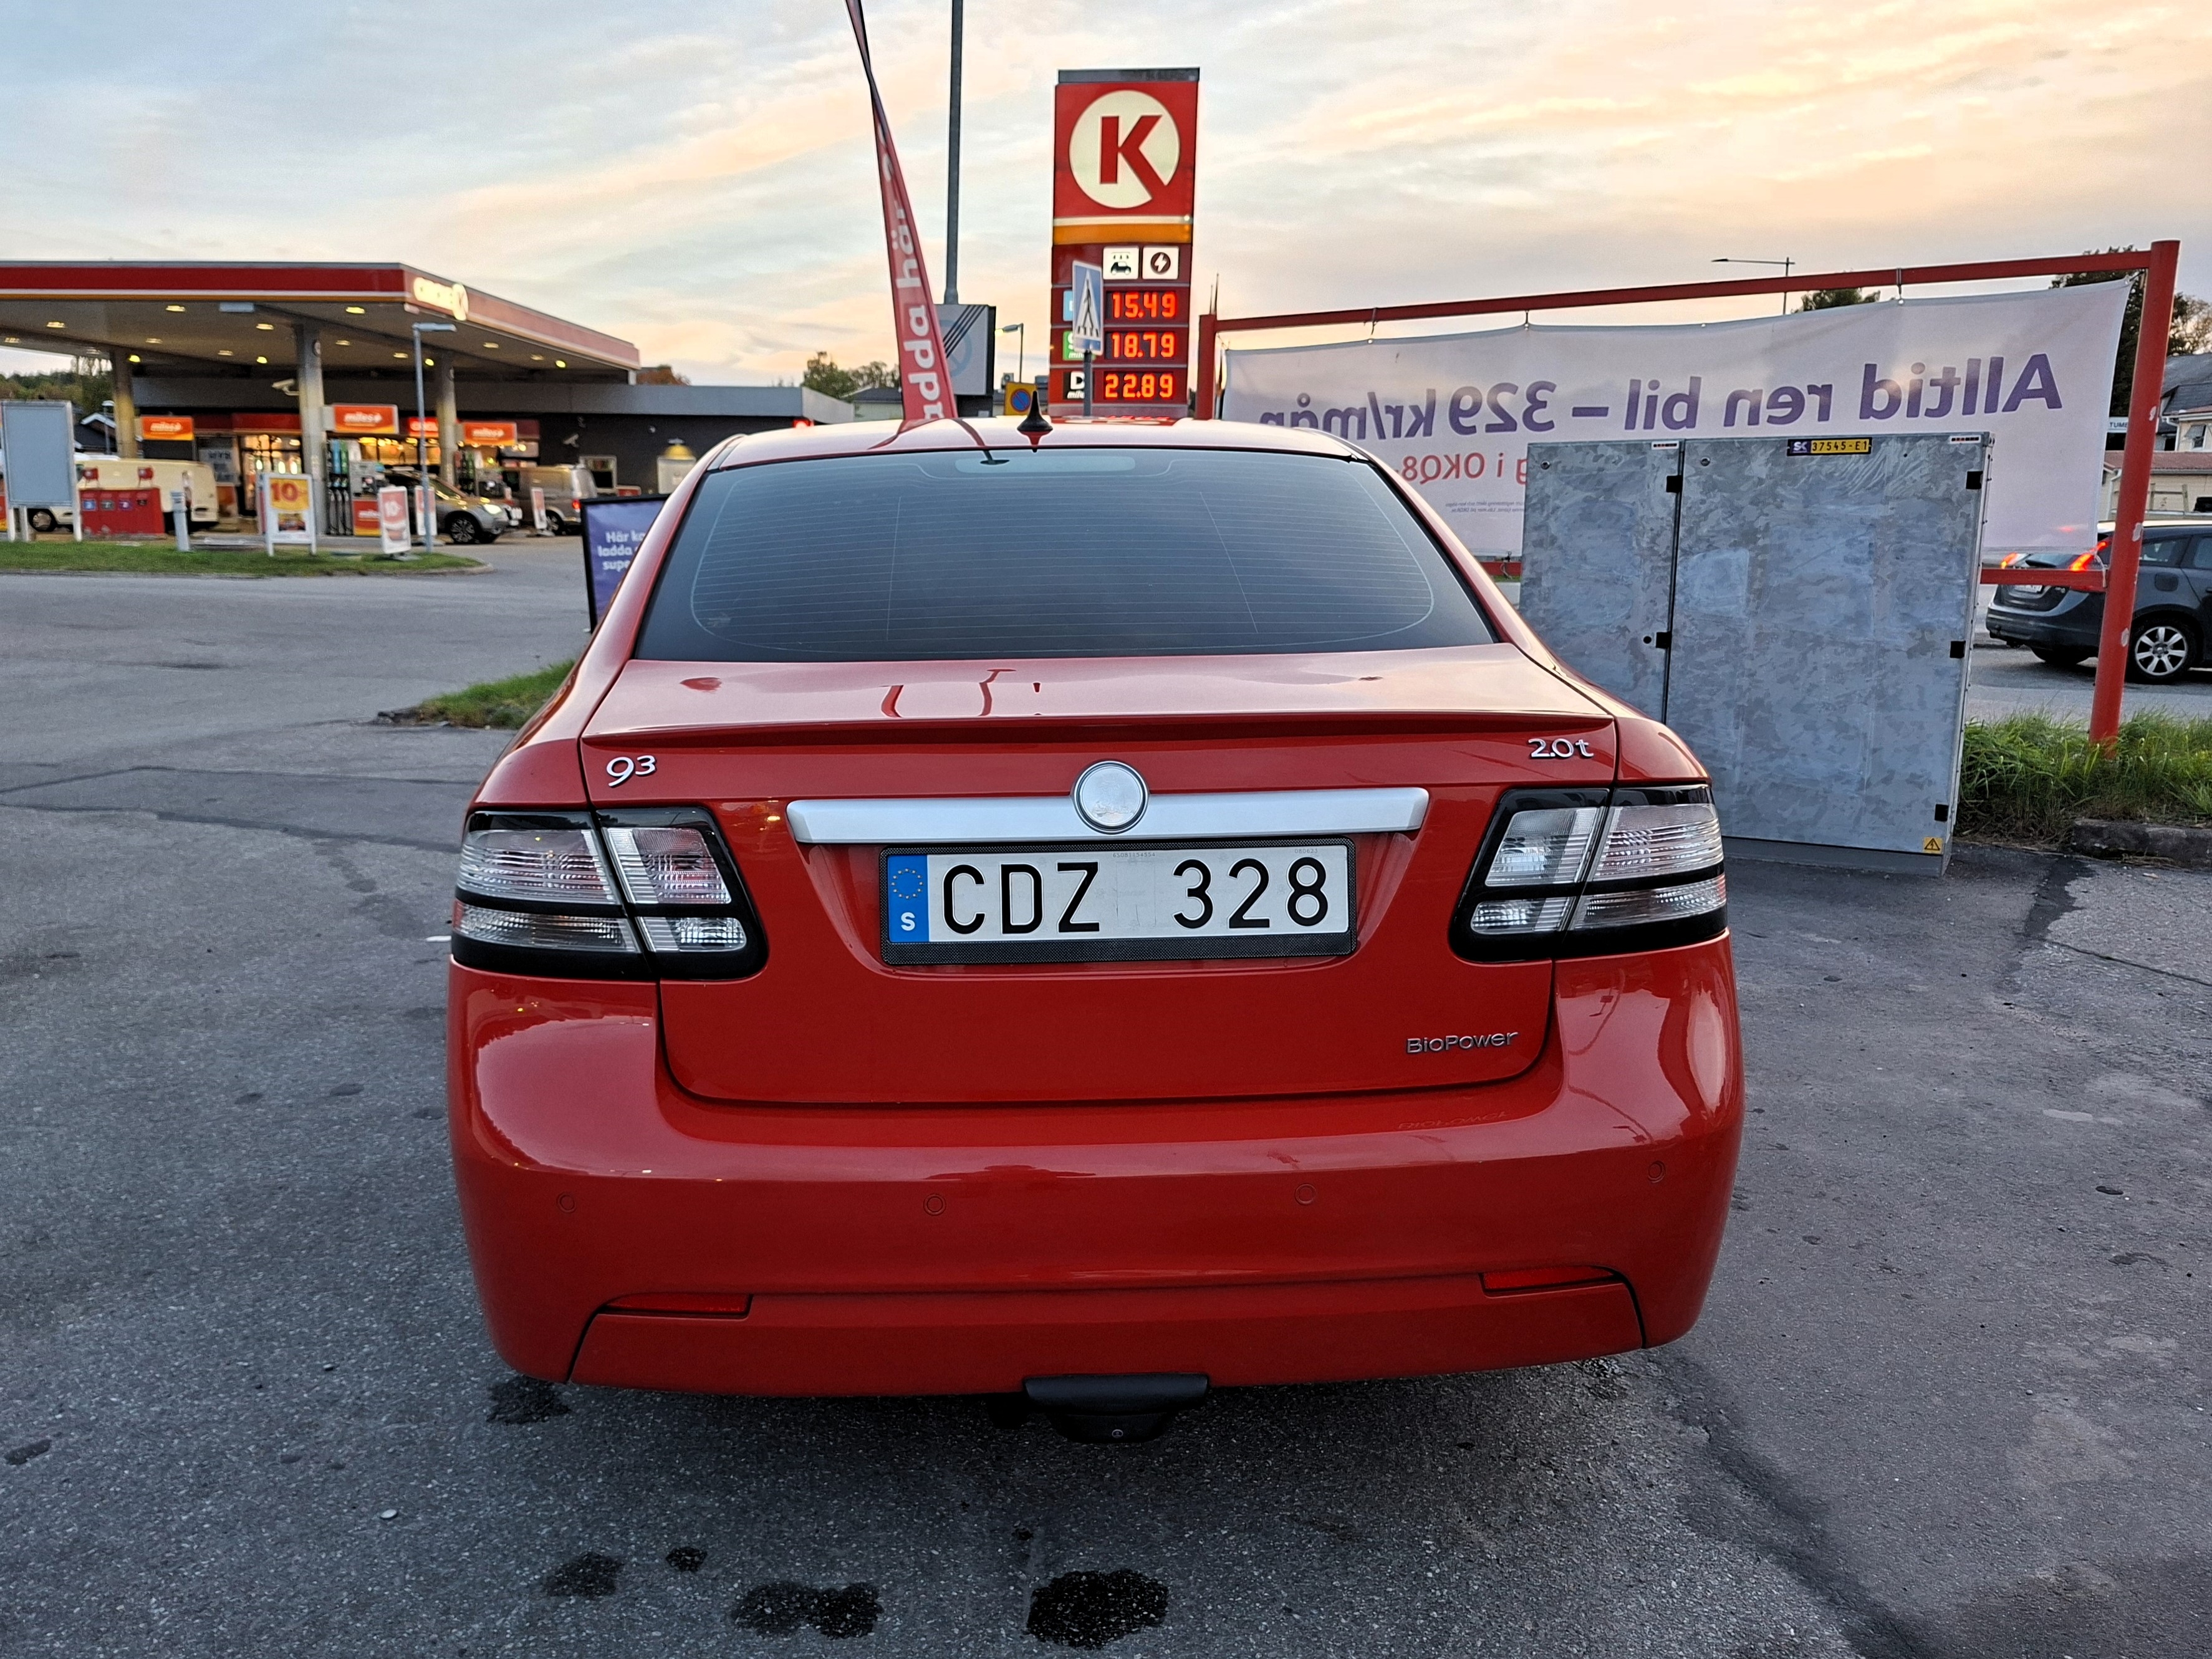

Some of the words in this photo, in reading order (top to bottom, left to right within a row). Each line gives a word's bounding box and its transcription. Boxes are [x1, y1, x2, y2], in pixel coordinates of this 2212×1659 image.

[1100, 115, 1166, 192] K
[1112, 291, 1176, 318] 15.49
[1112, 332, 1175, 358] 18.79
[1070, 371, 1085, 390] D
[1105, 373, 1173, 398] 22.89
[606, 531, 629, 542] Här
[597, 544, 632, 557] ladda
[1528, 738, 1594, 757] 2.0t
[901, 911, 915, 931] S
[943, 862, 1100, 935] CDZ
[1173, 857, 1329, 929] 328
[1407, 1032, 1519, 1054] BioPower
